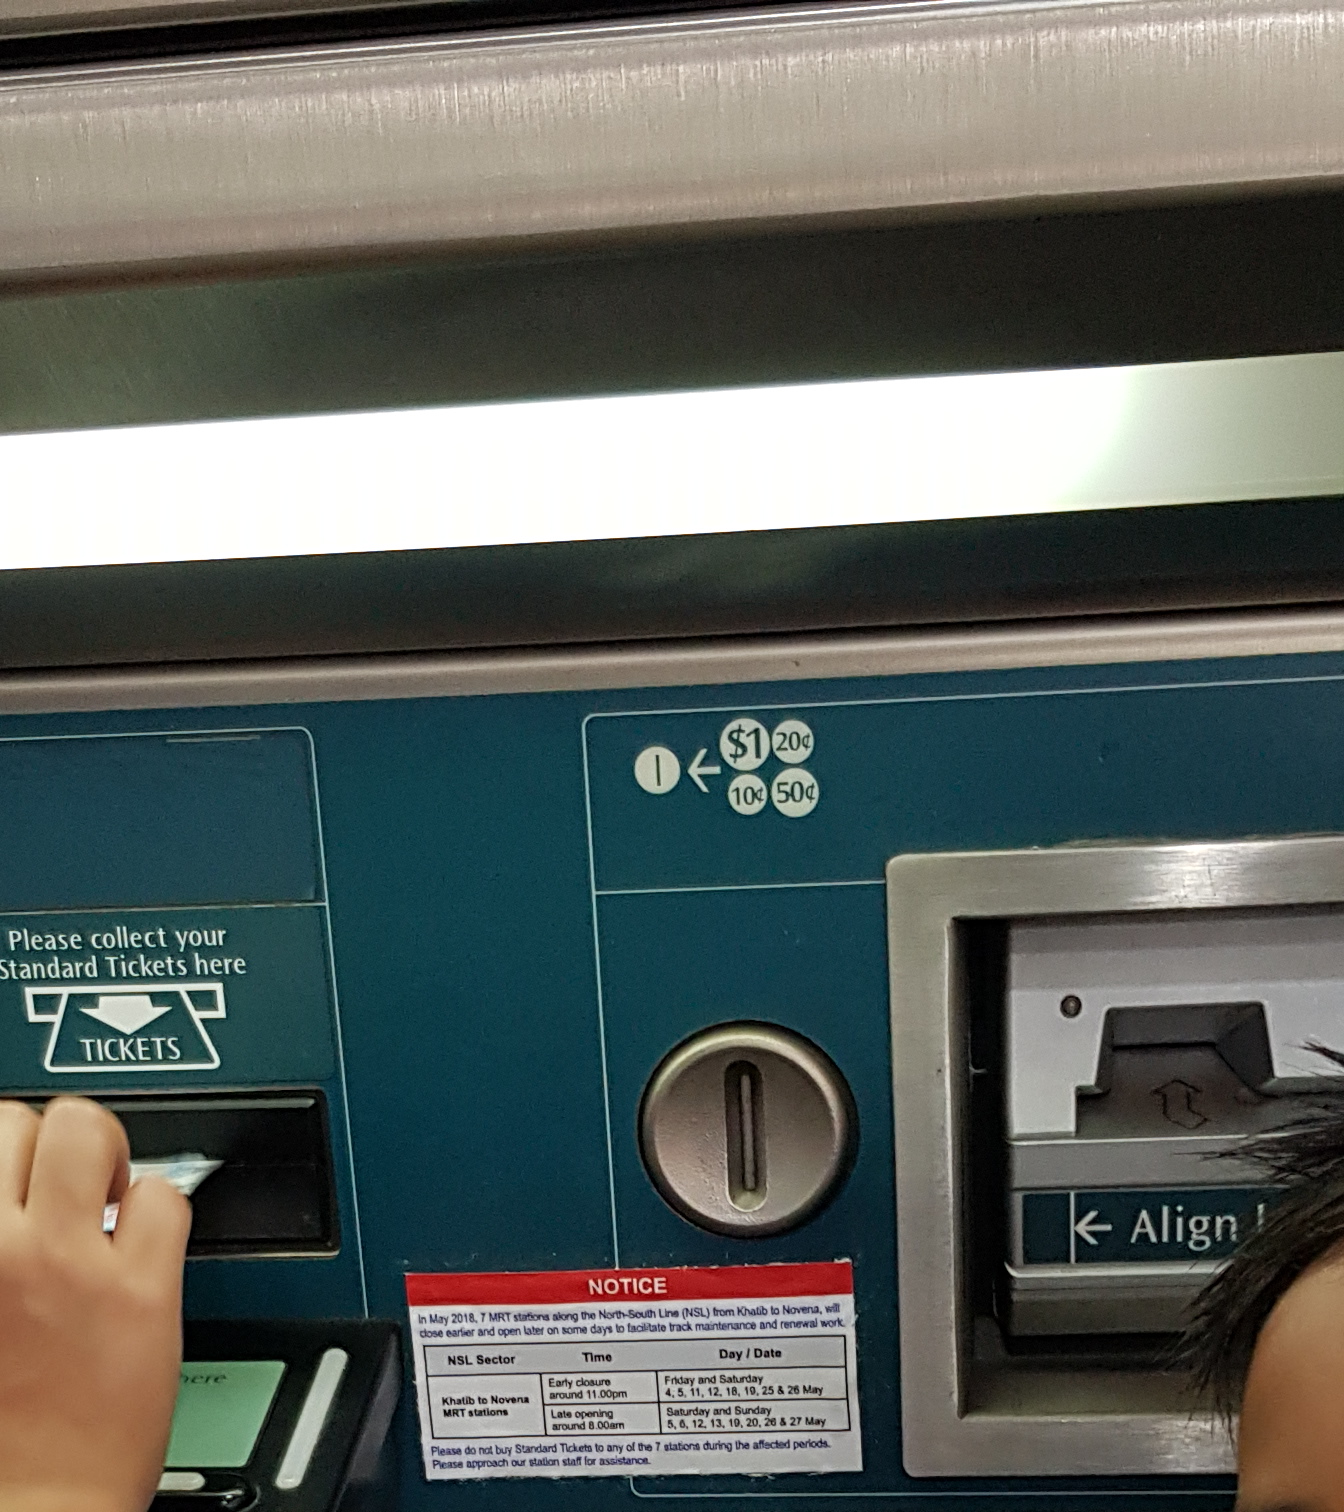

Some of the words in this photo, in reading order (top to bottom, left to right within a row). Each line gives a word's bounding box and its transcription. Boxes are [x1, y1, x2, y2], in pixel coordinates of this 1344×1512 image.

[727, 724, 762, 764] $1
[775, 731, 812, 752] 20¢
[731, 786, 764, 806] 10¢
[776, 781, 816, 804] 50¢
[8, 928, 83, 951] Please
[91, 926, 167, 949] collect
[175, 928, 227, 952] your
[105, 953, 187, 978] Tickets
[194, 952, 247, 975] here
[80, 1036, 181, 1062] TICKETS
[1131, 1204, 1238, 1251] Align
[588, 1277, 668, 1296] NOTICE
[429, 1314, 449, 1326] May
[451, 1313, 478, 1325] 2018,
[480, 1312, 486, 1323] 7
[489, 1312, 512, 1323] MRT
[514, 1312, 550, 1322] stations
[552, 1311, 578, 1323] along
[581, 1311, 596, 1320] the
[658, 1308, 679, 1318] Line
[682, 1307, 710, 1319] (NSL)
[713, 1306, 734, 1317] from
[737, 1305, 768, 1316] Khatib
[770, 1305, 780, 1315] to
[782, 1304, 823, 1316] Novena,
[825, 1303, 841, 1313] will
[448, 1355, 472, 1366] NSL
[476, 1354, 515, 1365] Sector
[582, 1352, 612, 1363] Time
[719, 1348, 741, 1361] Day
[754, 1348, 782, 1359] Date
[549, 1378, 573, 1389] Early
[576, 1377, 611, 1387] closure
[665, 1375, 695, 1386] Friday
[698, 1375, 717, 1384] and
[719, 1374, 763, 1385] Saturday
[442, 1396, 475, 1405] Khatib
[478, 1396, 488, 1404] to
[491, 1395, 530, 1404] Novena
[549, 1390, 583, 1400] around
[587, 1390, 628, 1401] 11.00pm
[443, 1408, 466, 1417] MRT
[468, 1407, 509, 1417] stations
[551, 1410, 572, 1419] Late
[575, 1409, 614, 1421] opening
[667, 1406, 710, 1417] Saturday
[713, 1406, 732, 1416] and
[735, 1406, 772, 1417] Sunday
[552, 1422, 586, 1431] around
[589, 1421, 625, 1430] 8.00am
